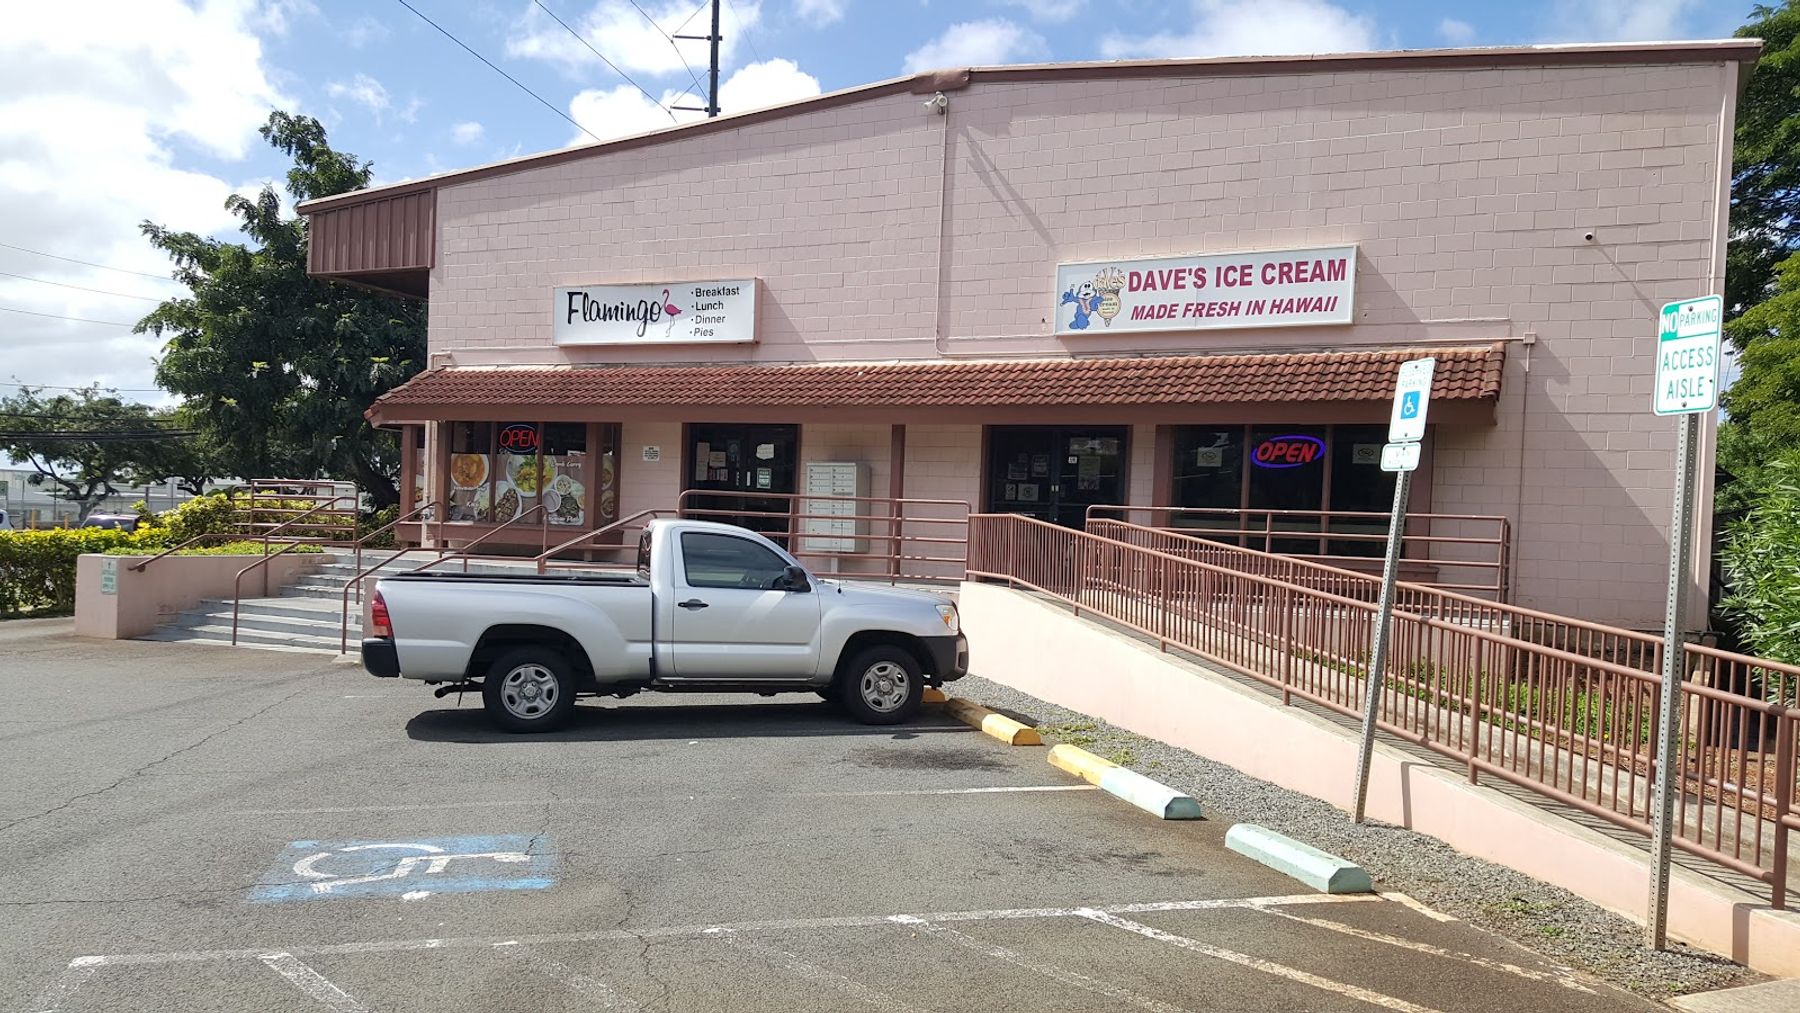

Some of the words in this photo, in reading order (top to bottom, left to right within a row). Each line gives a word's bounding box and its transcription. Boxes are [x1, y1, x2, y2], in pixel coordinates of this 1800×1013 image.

[1128, 267, 1206, 292] DAVE'S
[1215, 264, 1253, 288] ICE
[1261, 258, 1347, 285] CREAM
[695, 286, 740, 297] Breakfast
[567, 291, 662, 338] Flamingo
[695, 300, 724, 311] Lunch
[1130, 302, 1179, 321] MADE
[1182, 300, 1242, 318] FRESH
[1245, 299, 1268, 315] IN
[1269, 296, 1339, 315] HAWAII
[695, 314, 726, 325] Dinner
[1662, 311, 1678, 334] NO
[1679, 308, 1717, 328] PARKING
[694, 327, 714, 337] Pies
[1662, 345, 1714, 372] ACCESS
[1666, 376, 1705, 400] AISLE
[500, 429, 539, 448] OPEN
[1256, 440, 1318, 463] OPEN
